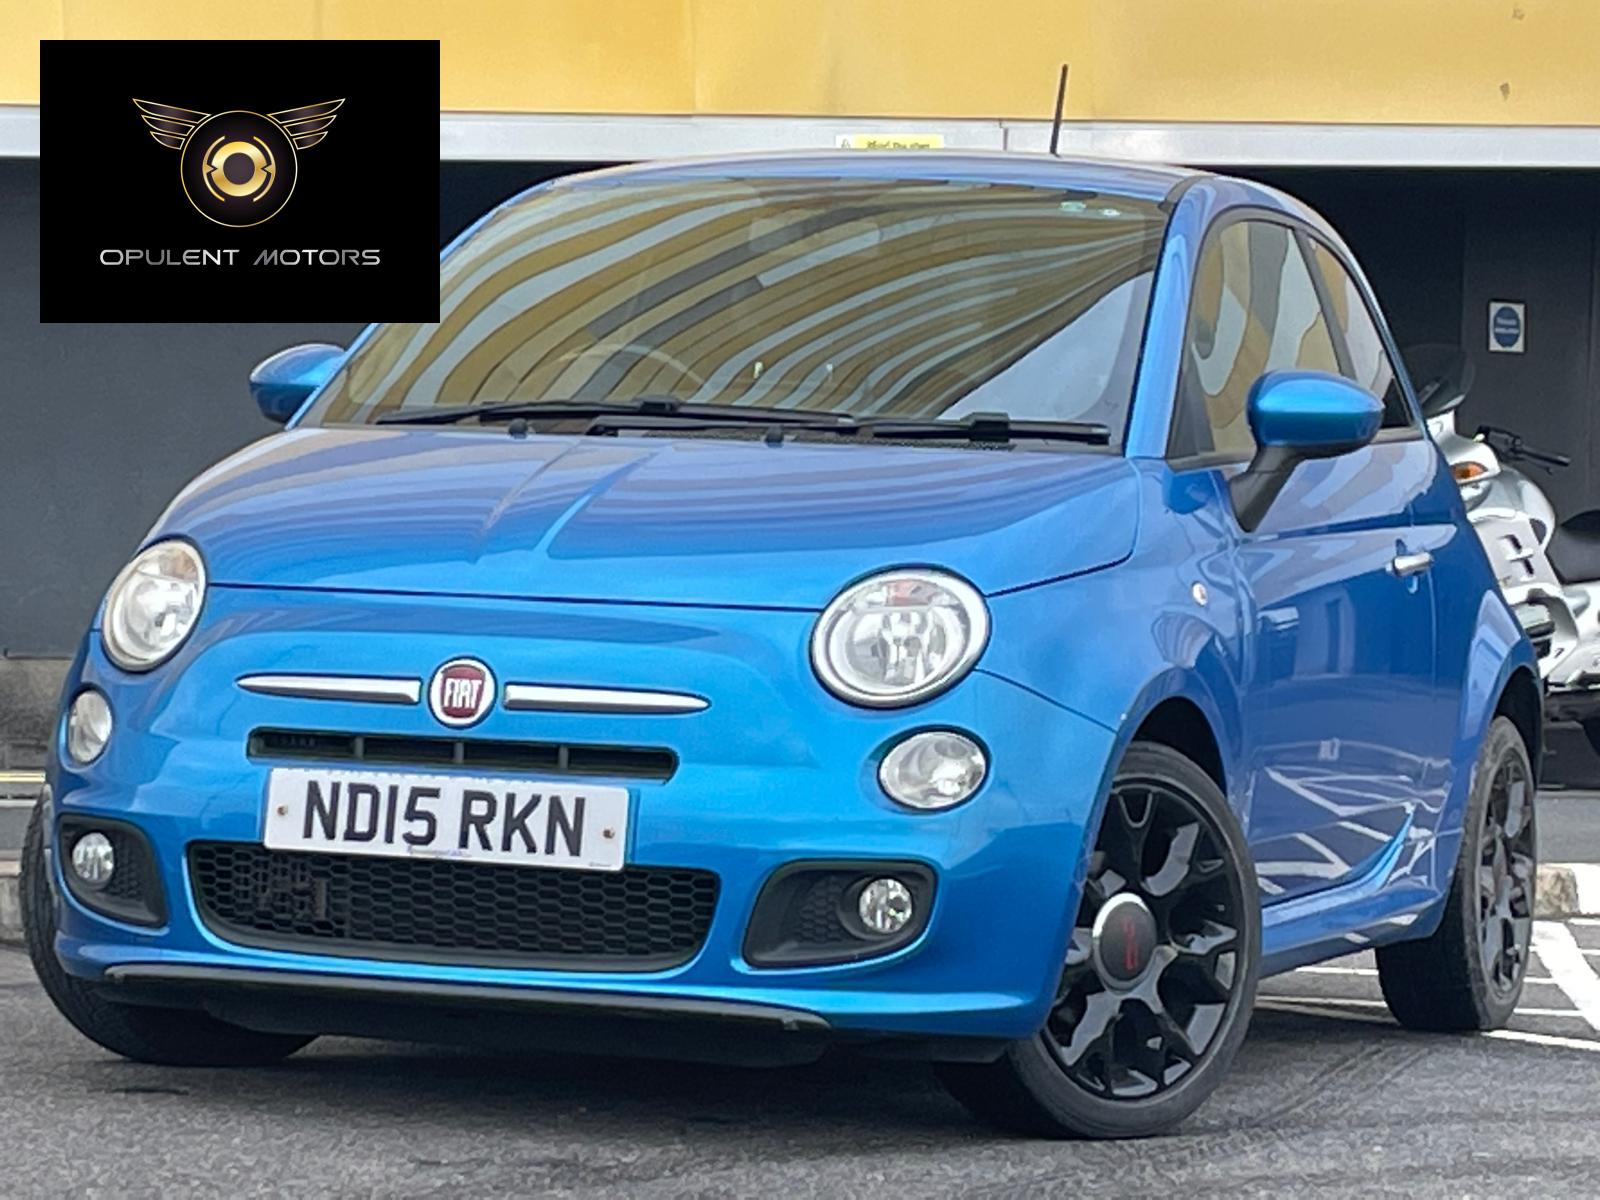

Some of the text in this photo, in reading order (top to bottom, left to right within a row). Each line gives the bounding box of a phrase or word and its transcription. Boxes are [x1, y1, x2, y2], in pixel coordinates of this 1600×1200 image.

[444, 677, 483, 709] FIAT
[303, 780, 586, 857] ND15 RKN
